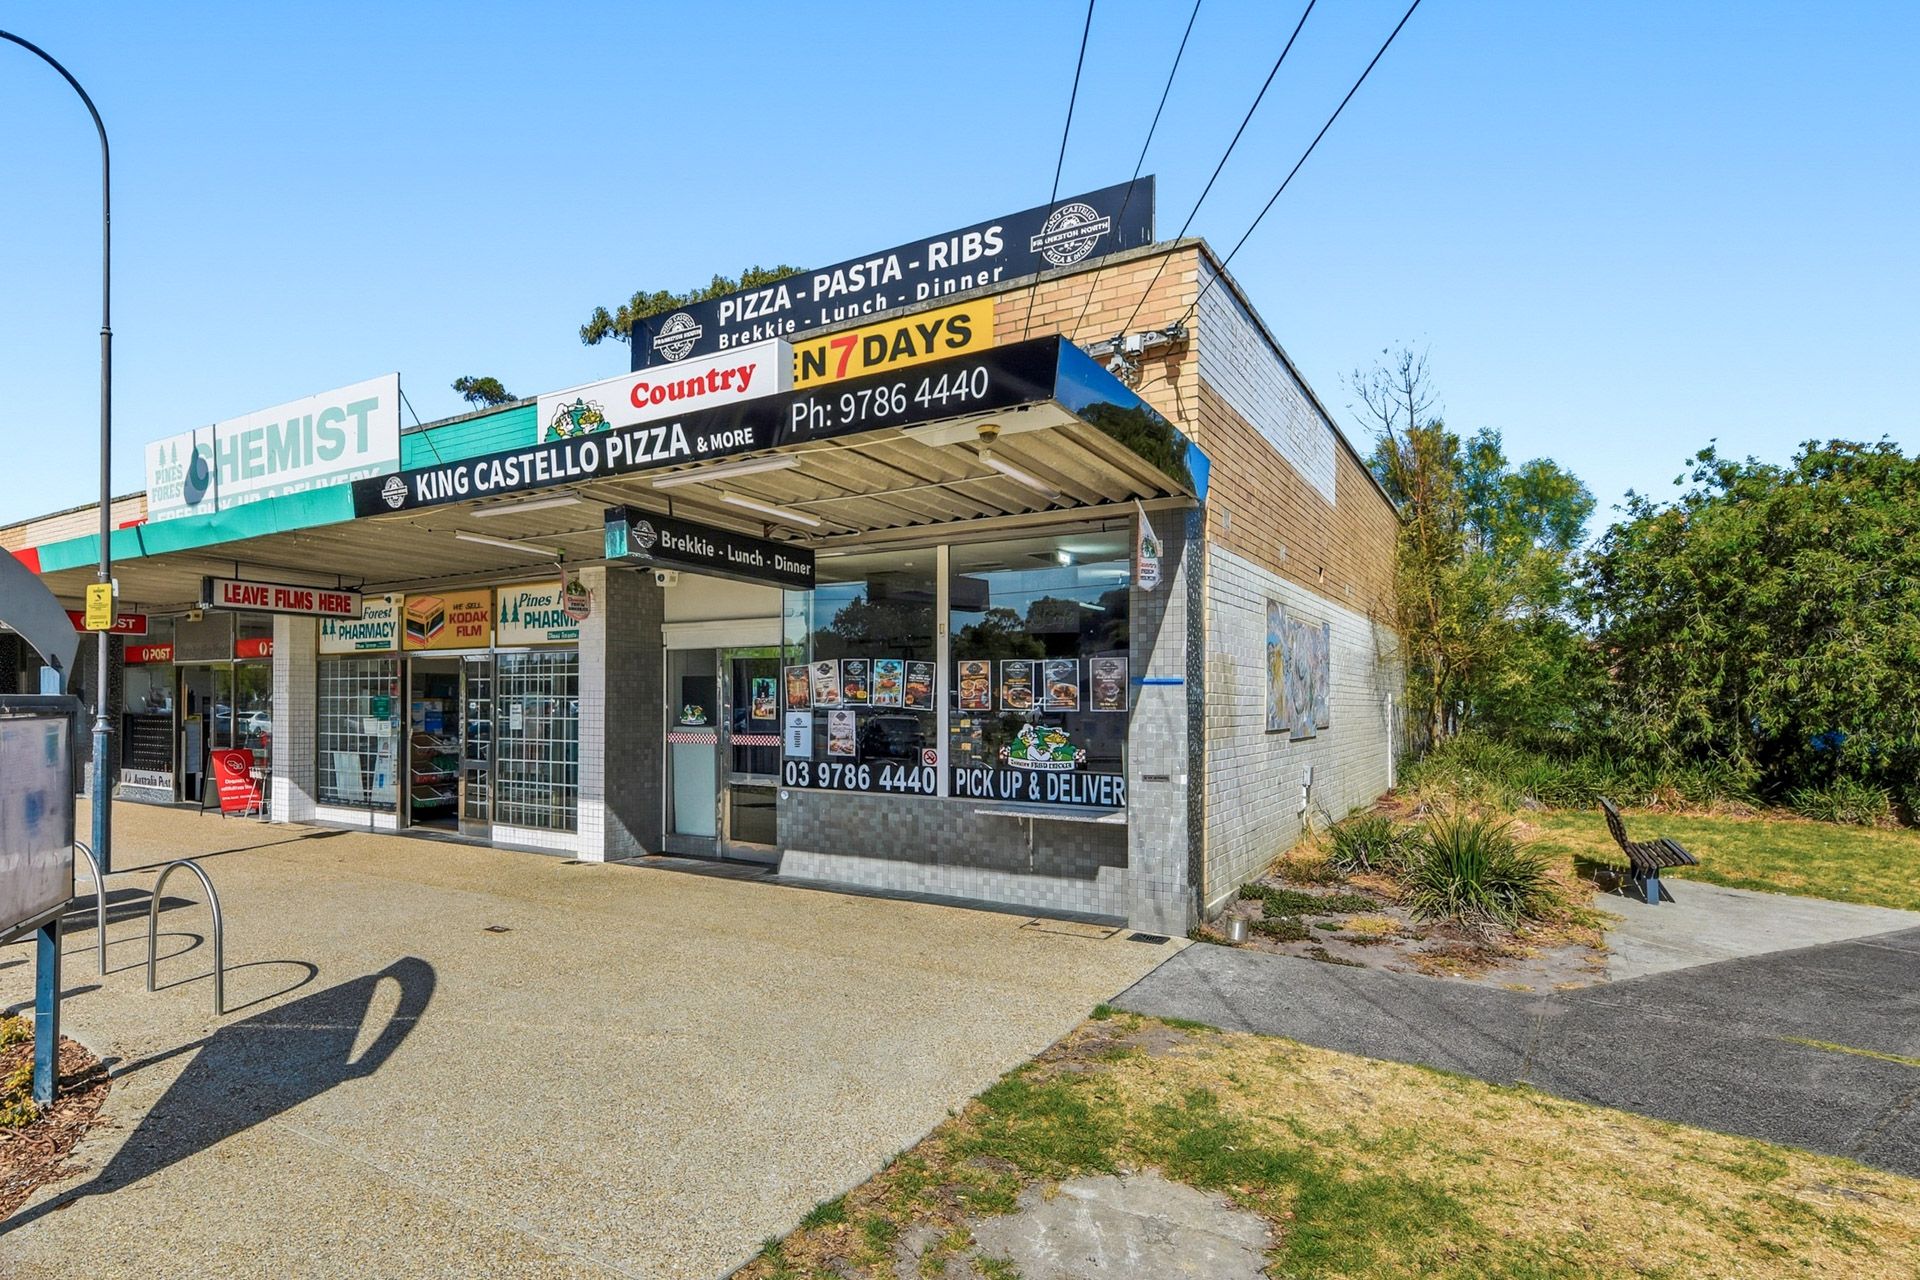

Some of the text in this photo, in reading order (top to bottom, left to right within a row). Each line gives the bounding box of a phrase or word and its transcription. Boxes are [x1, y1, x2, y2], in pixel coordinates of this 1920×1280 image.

[720, 284, 791, 326] PIZZA
[814, 254, 902, 302] PASTA
[928, 226, 1004, 271] RIBS
[720, 318, 795, 350] Brekkie
[822, 292, 886, 325] Lunch
[917, 265, 1003, 301] Dinner
[830, 334, 858, 378] 7
[863, 314, 972, 368] DAYS
[630, 364, 756, 408] Country
[792, 366, 989, 432] Ph: 9786 4440
[192, 396, 378, 487] CHEMIST
[155, 464, 183, 484] PINES
[416, 466, 470, 500] KING
[474, 440, 599, 490] CASTELLO
[606, 422, 690, 470] PIZZA
[697, 436, 708, 452] &
[710, 427, 754, 450] MORE
[152, 481, 184, 502] FORES
[198, 498, 232, 514] PIK
[661, 530, 714, 557] Brekkie
[728, 544, 764, 566] Lunch
[774, 555, 811, 576] Dinner
[224, 584, 351, 614] LEAVE FILMS HERE
[364, 606, 392, 620] Forest
[465, 602, 483, 610] SELL
[518, 592, 552, 608] Pines
[338, 622, 396, 640] PHARMACY
[450, 610, 488, 624] KODAK
[456, 625, 482, 638] FILM
[150, 648, 170, 660] POST
[786, 760, 936, 794] 03 9786 4440
[956, 768, 1126, 806] PICK UP & DELIVER
